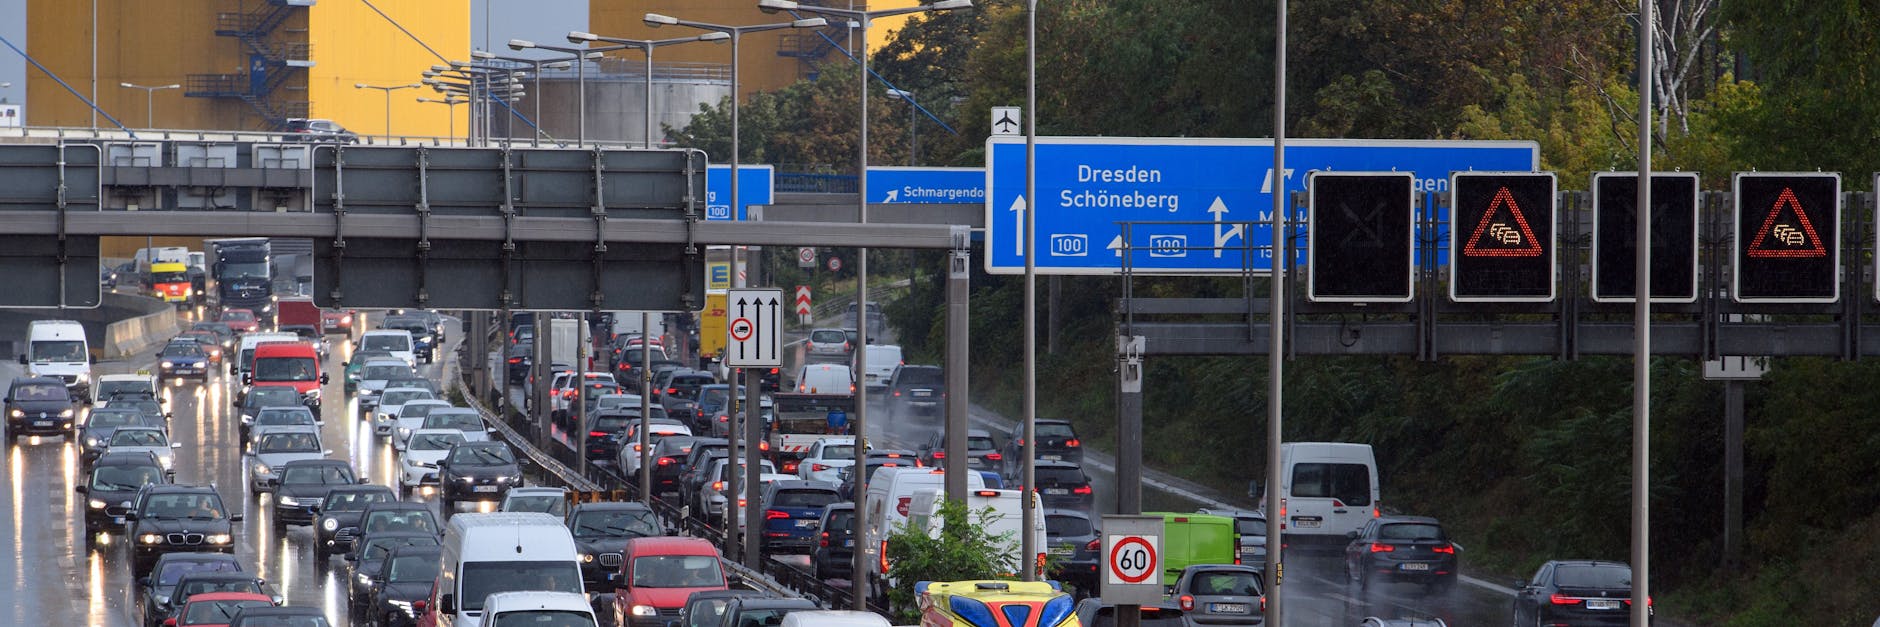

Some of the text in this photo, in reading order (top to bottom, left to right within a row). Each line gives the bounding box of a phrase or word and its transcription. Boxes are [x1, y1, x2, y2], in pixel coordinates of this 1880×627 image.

[1078, 165, 1161, 183] Dresden
[904, 186, 984, 200] Schmargendo
[1060, 190, 1179, 213] Schöneberg
[711, 207, 726, 216] 100
[1057, 238, 1081, 252] 100
[1157, 240, 1180, 253] 100
[1120, 549, 1146, 570] 60
